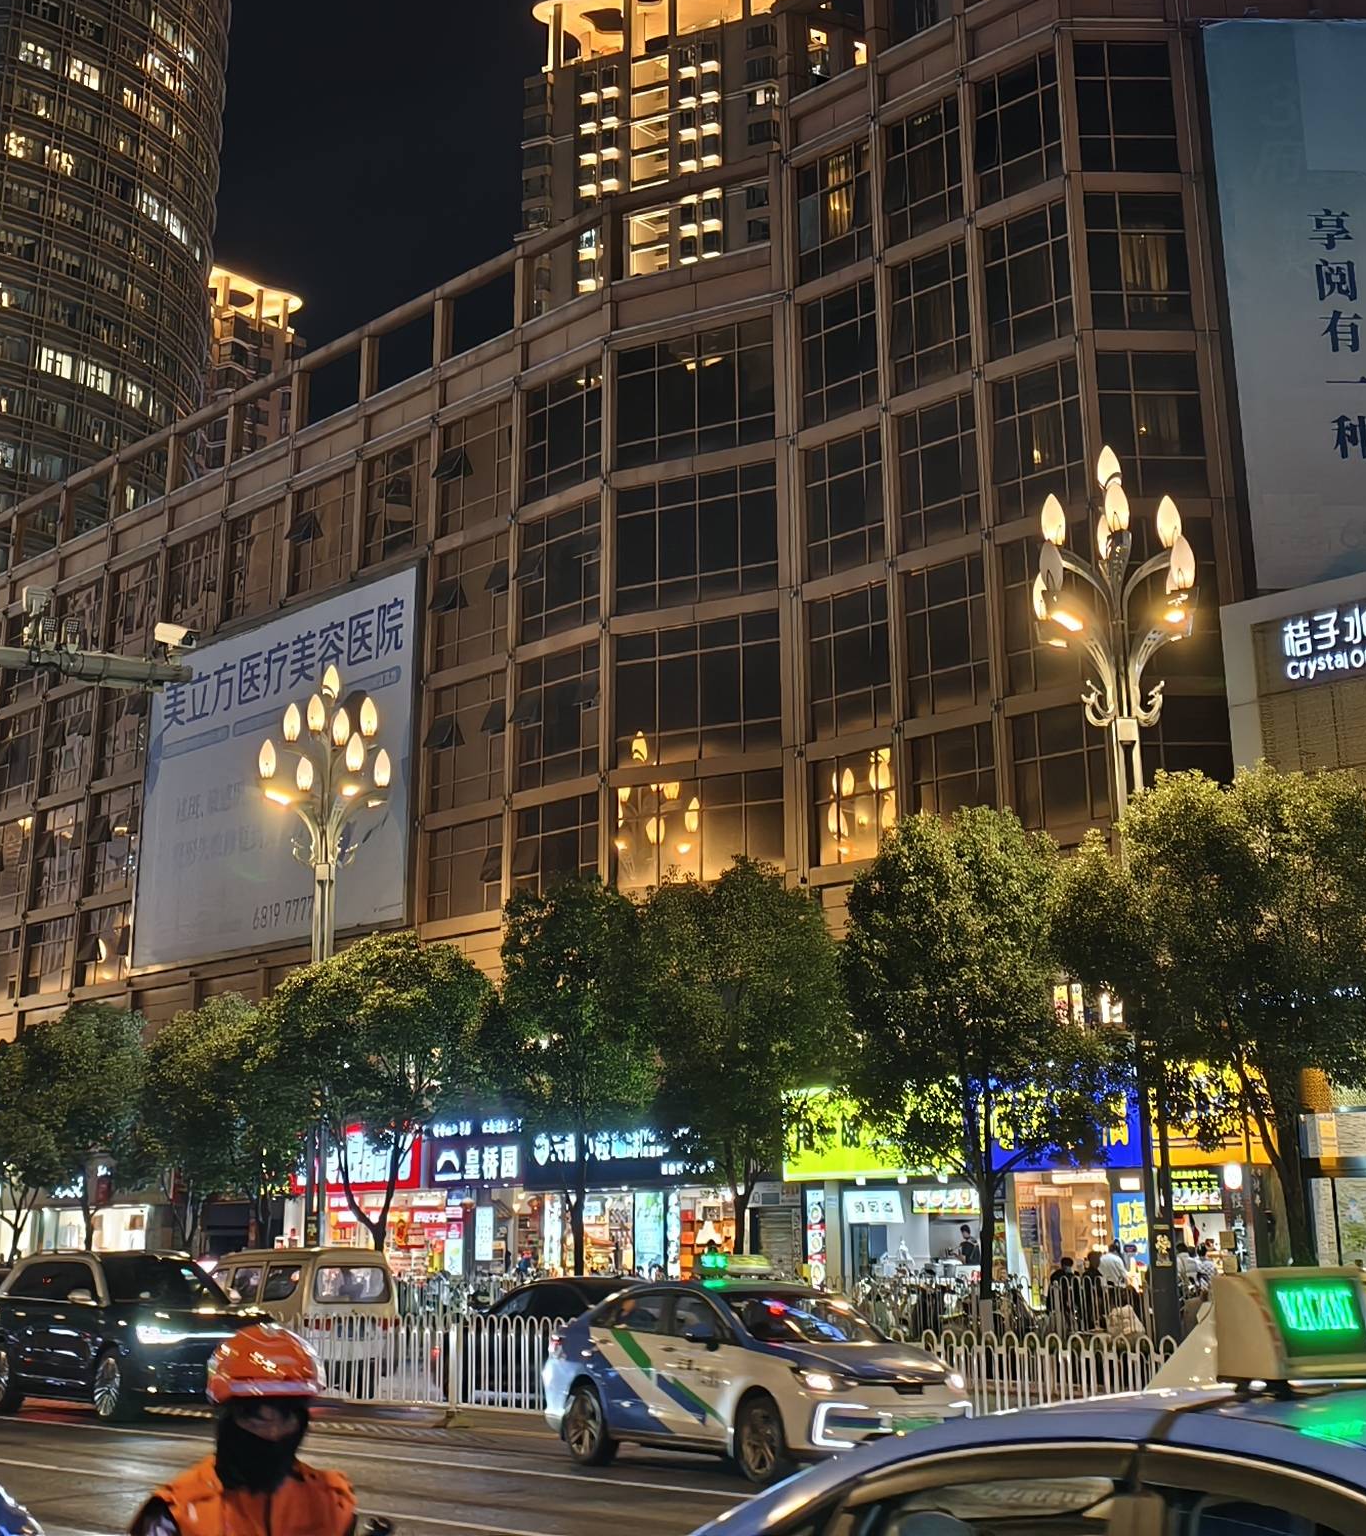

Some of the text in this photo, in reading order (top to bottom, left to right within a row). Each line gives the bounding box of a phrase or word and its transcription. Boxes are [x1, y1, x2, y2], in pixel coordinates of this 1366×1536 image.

[163, 597, 405, 733] 美立方医疗美容医院
[1286, 651, 1349, 680] Crystal
[1275, 1287, 1360, 1332] VACANT
